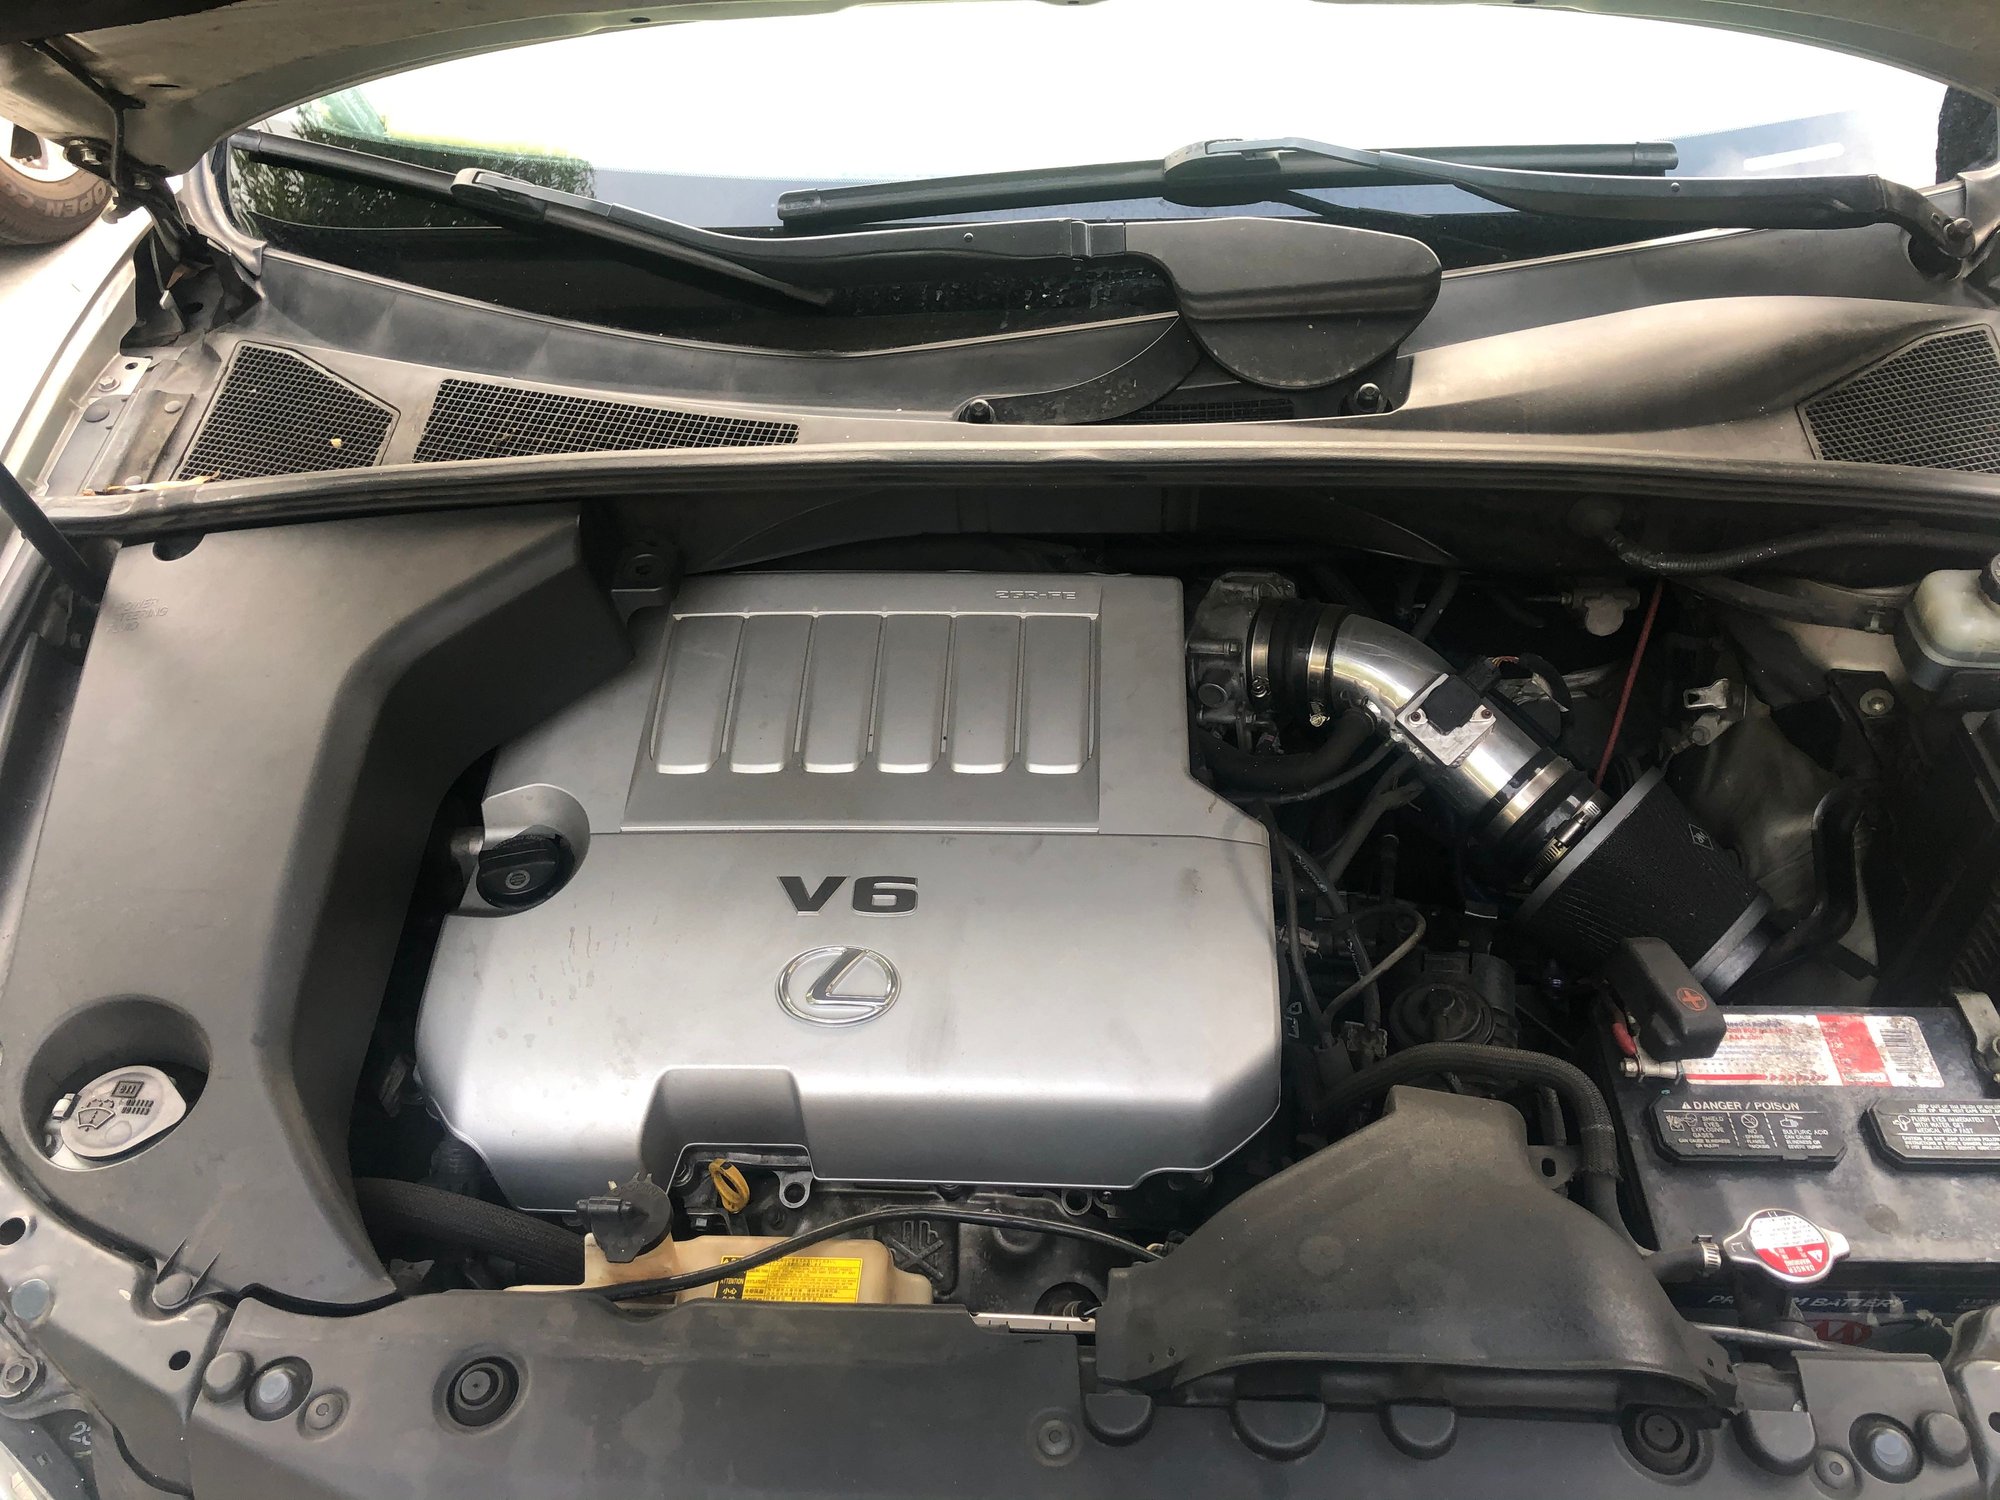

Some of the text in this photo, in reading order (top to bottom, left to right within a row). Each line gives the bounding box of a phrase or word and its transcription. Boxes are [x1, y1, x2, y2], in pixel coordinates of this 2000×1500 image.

[45, 180, 107, 218] OPEN
[994, 590, 1077, 600] 2GR-FE
[777, 875, 918, 917] V6
[1694, 1102, 1742, 1110] DANGER
[1754, 1102, 1800, 1111] POISON
[1787, 1265, 1815, 1273] DANGER
